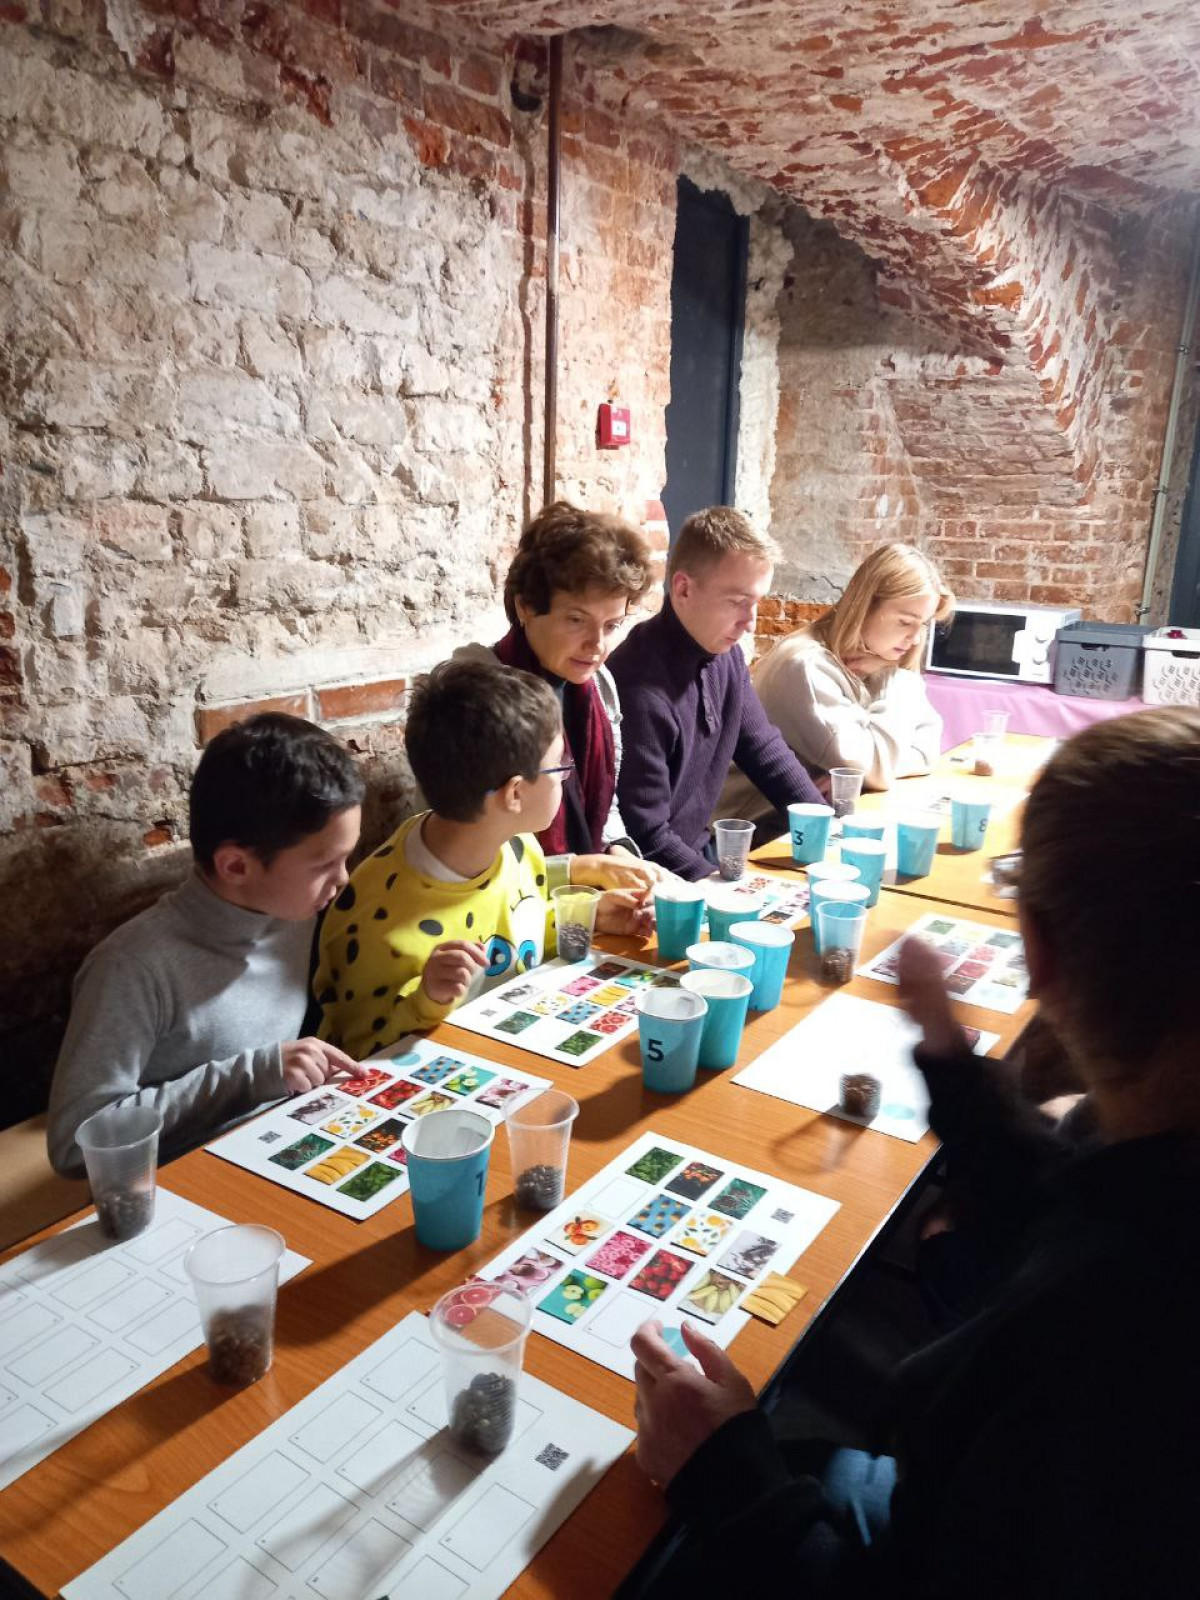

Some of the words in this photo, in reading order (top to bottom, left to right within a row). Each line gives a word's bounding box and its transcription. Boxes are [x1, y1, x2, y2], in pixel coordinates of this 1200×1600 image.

[793, 830, 804, 845] 3
[647, 1038, 664, 1062] 5
[475, 1171, 484, 1196] 1
